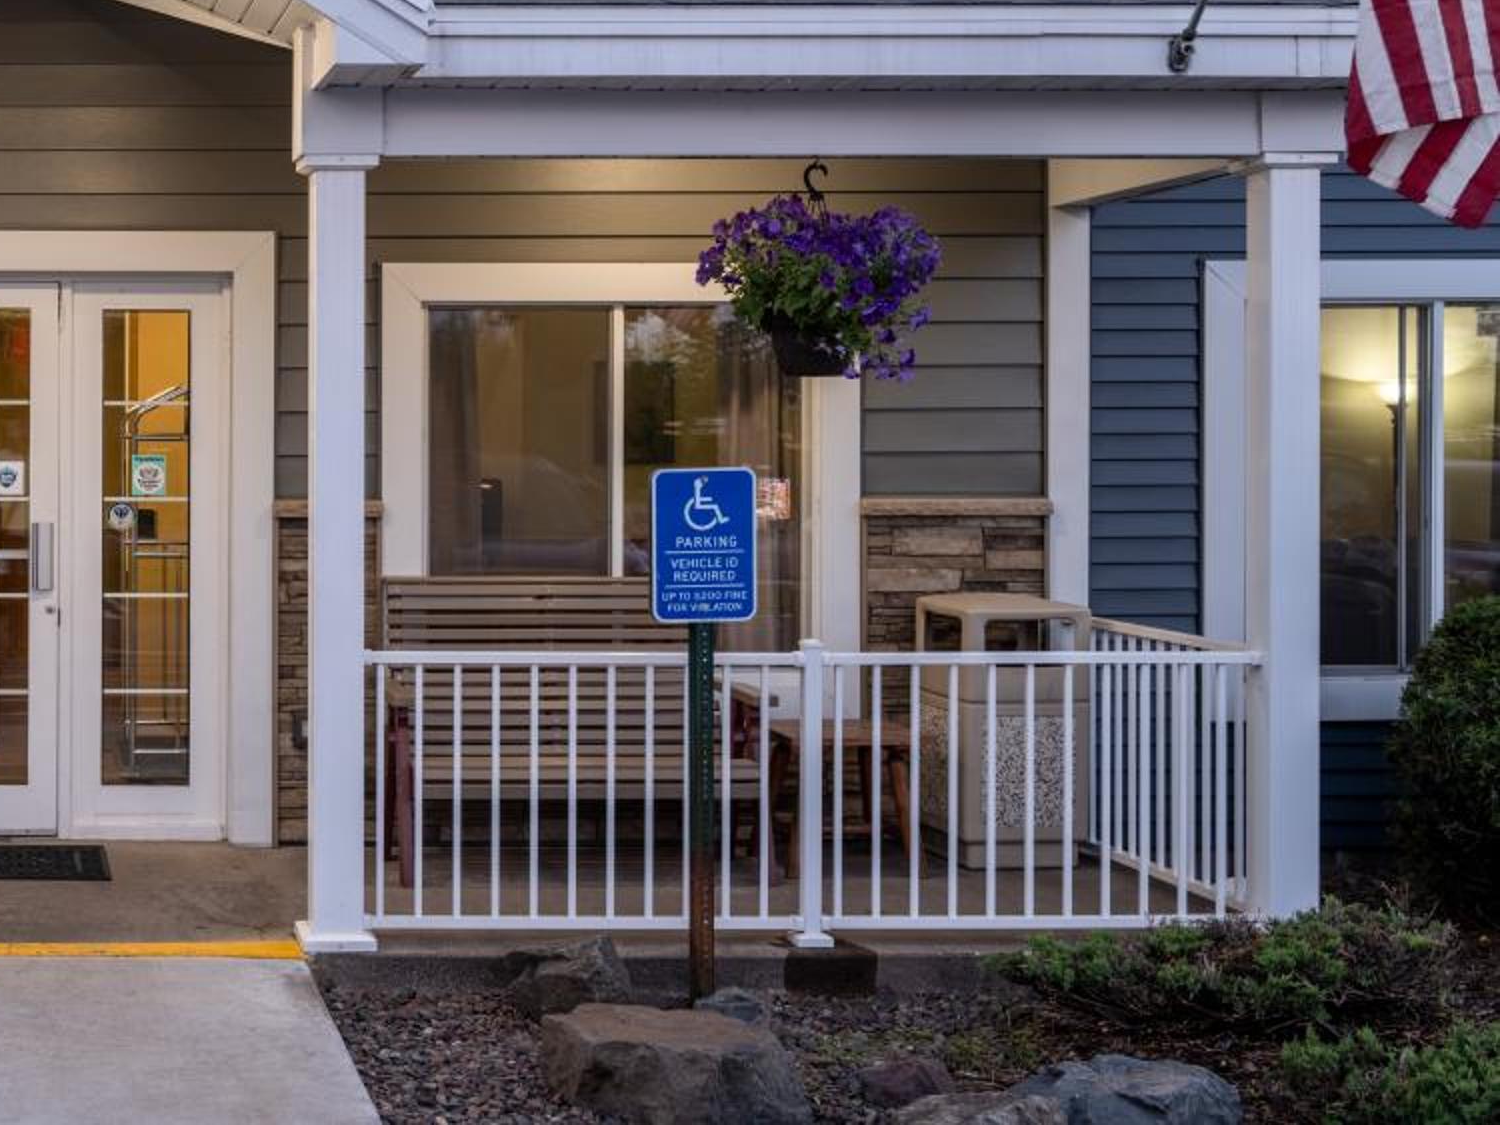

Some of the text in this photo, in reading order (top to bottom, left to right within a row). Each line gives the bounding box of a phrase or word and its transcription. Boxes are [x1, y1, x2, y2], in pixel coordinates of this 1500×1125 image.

[676, 535, 737, 548] PARKING
[671, 558, 722, 569] VEHICLE
[673, 570, 736, 582] REQUIRED
[662, 592, 677, 601] UP
[679, 592, 690, 601] TO
